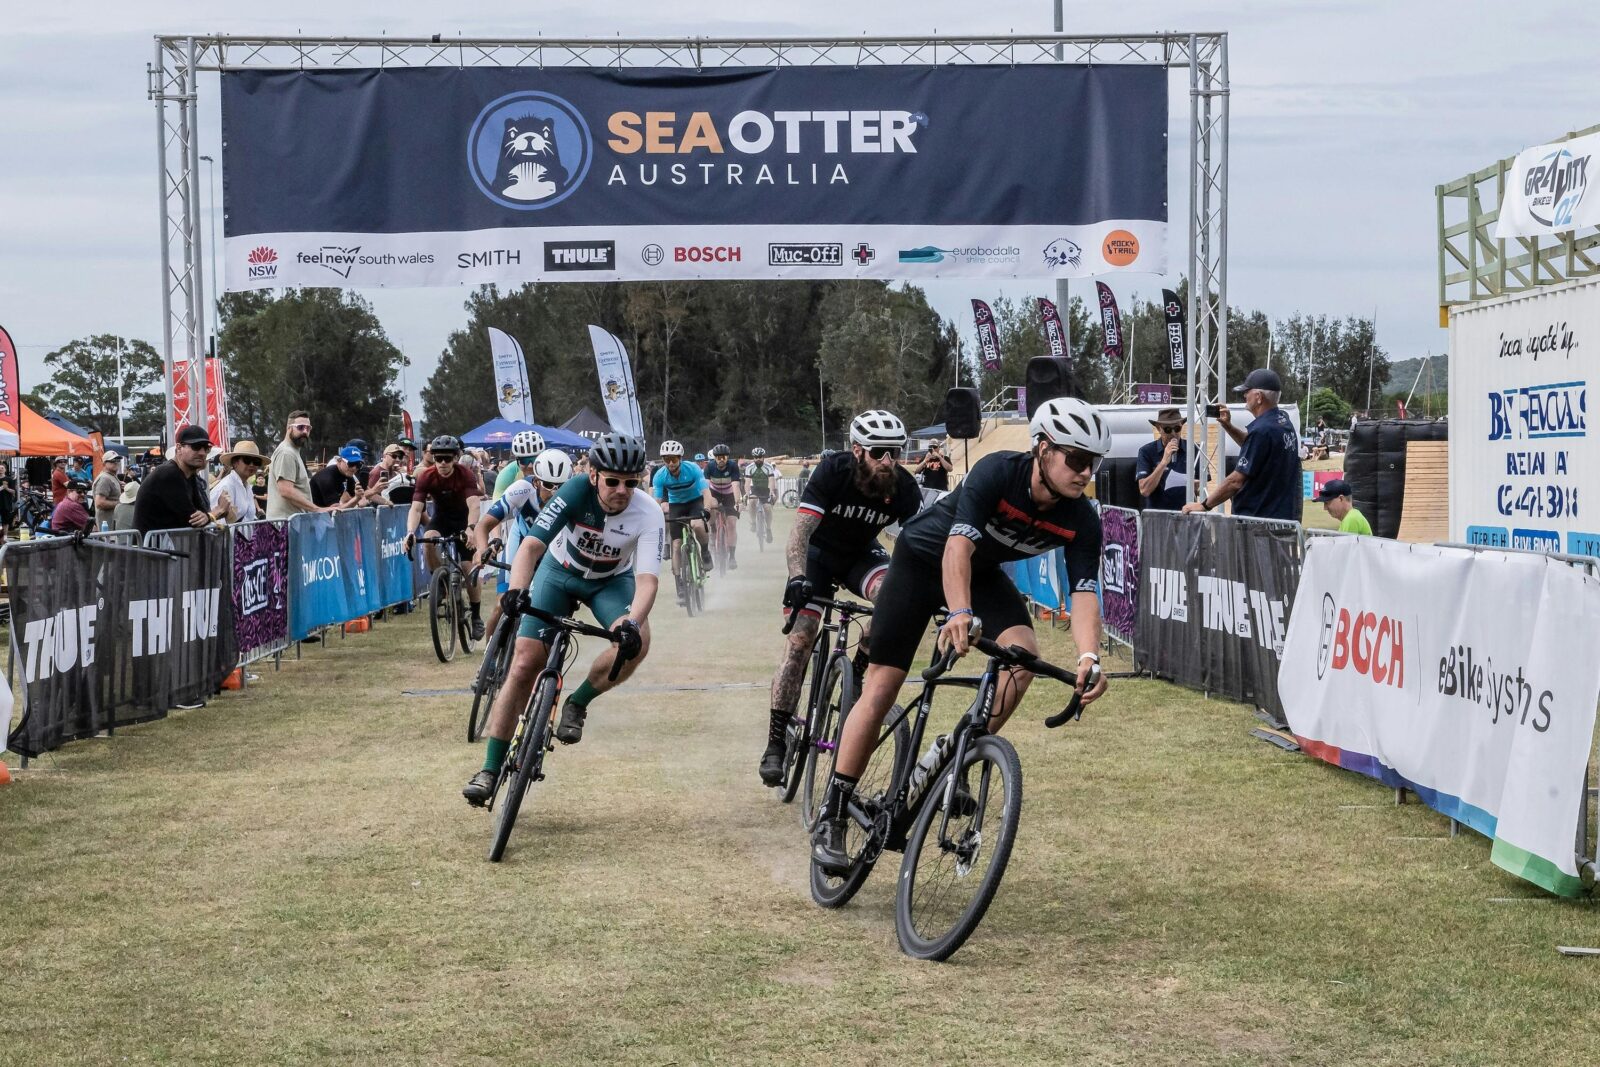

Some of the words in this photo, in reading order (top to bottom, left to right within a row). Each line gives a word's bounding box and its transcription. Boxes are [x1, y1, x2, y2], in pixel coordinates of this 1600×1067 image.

[607, 111, 724, 154] SEA
[728, 110, 918, 154] OTTER
[607, 163, 849, 186] AUSTRALIA
[1525, 148, 1592, 208] GRAVITY
[297, 252, 323, 264] feel
[326, 253, 356, 264] new
[358, 253, 396, 265] south
[399, 252, 435, 264] wales
[457, 250, 521, 268] SMITH
[552, 247, 607, 264] THULE
[674, 246, 741, 262] BOSCH
[773, 246, 840, 263] Muc-Off
[952, 246, 1020, 256] eurobodalla
[248, 265, 278, 277] NSW
[1104, 309, 1117, 345] Muc-Off
[1168, 324, 1182, 368] Muc-Off
[537, 496, 567, 531] BATCH
[577, 537, 621, 557] BATCH
[1150, 567, 1188, 622] THULE
[1198, 576, 1252, 638] THUE
[24, 605, 97, 683] THUE
[1438, 645, 1483, 704] eBike
